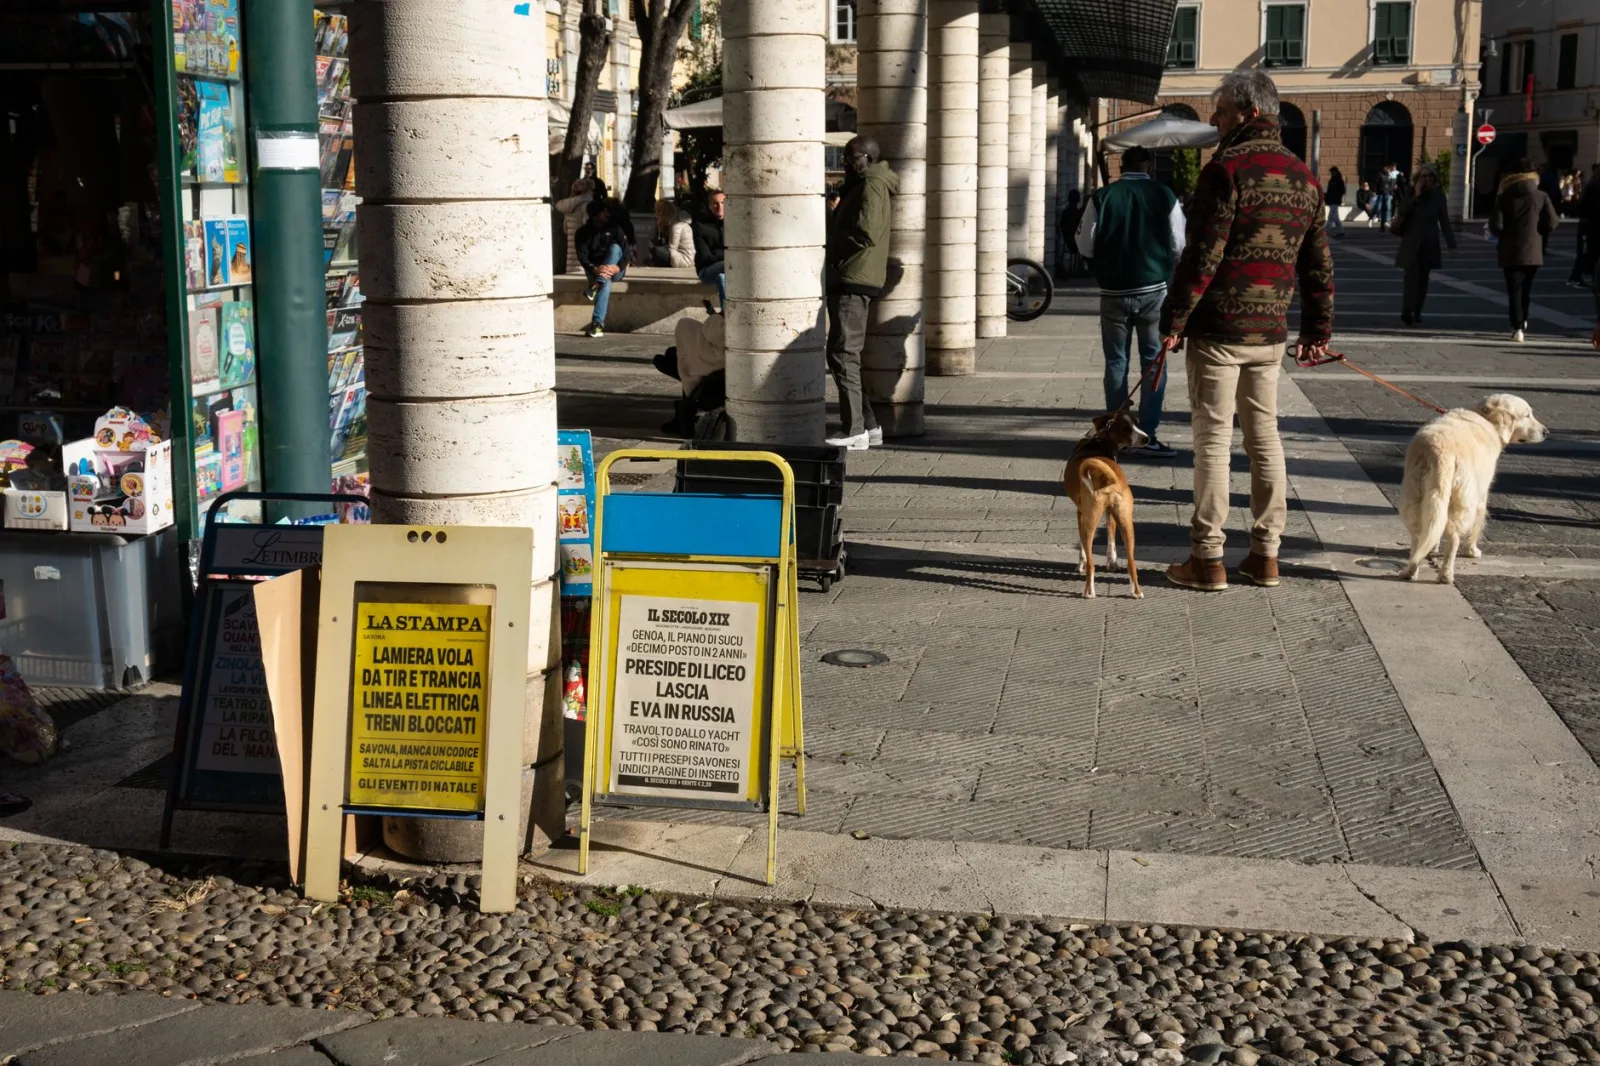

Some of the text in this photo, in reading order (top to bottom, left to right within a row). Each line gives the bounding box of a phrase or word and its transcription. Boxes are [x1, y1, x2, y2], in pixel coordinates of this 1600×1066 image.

[242, 531, 322, 566] LETIMBR
[367, 615, 483, 632] LA STAMPA
[647, 608, 730, 626] IL SECOLO XIX
[632, 629, 743, 646] GENOA, IL PIANO DI SUCU
[373, 646, 474, 666] LAMIERA VOLA
[626, 642, 747, 660] «DECIMO POSTO IN 2 ANNI»
[231, 671, 247, 684] LA
[625, 658, 746, 681] PRESIDE DI LICEO
[362, 669, 481, 689] DA TIR E TRANCIA
[656, 681, 709, 700] LASCIA
[212, 697, 257, 710] TEATRO
[363, 691, 480, 712] LINEA ELETTRICA
[222, 711, 237, 722] LA
[630, 701, 735, 723] E VA IN RUSSIA
[365, 713, 476, 734] TRENI BLOCCATI
[220, 728, 236, 741] LA
[623, 724, 741, 741] TRAVOLTO DALLO YACHT
[212, 741, 238, 756] DEL
[359, 743, 479, 758] SAVONA, MANCA UN CODICE
[632, 737, 730, 753] «COSÌ SONO RINATO»
[363, 758, 474, 772] SALTA LA PISTA CICLABILE
[619, 751, 647, 762] TUTTI
[652, 753, 691, 765] PRESEPI
[693, 756, 740, 769] SAVONESI
[618, 764, 740, 781] UNDICI PAGINE DI INSERTO
[358, 778, 478, 793] GLI EVENTI DI NATALE
